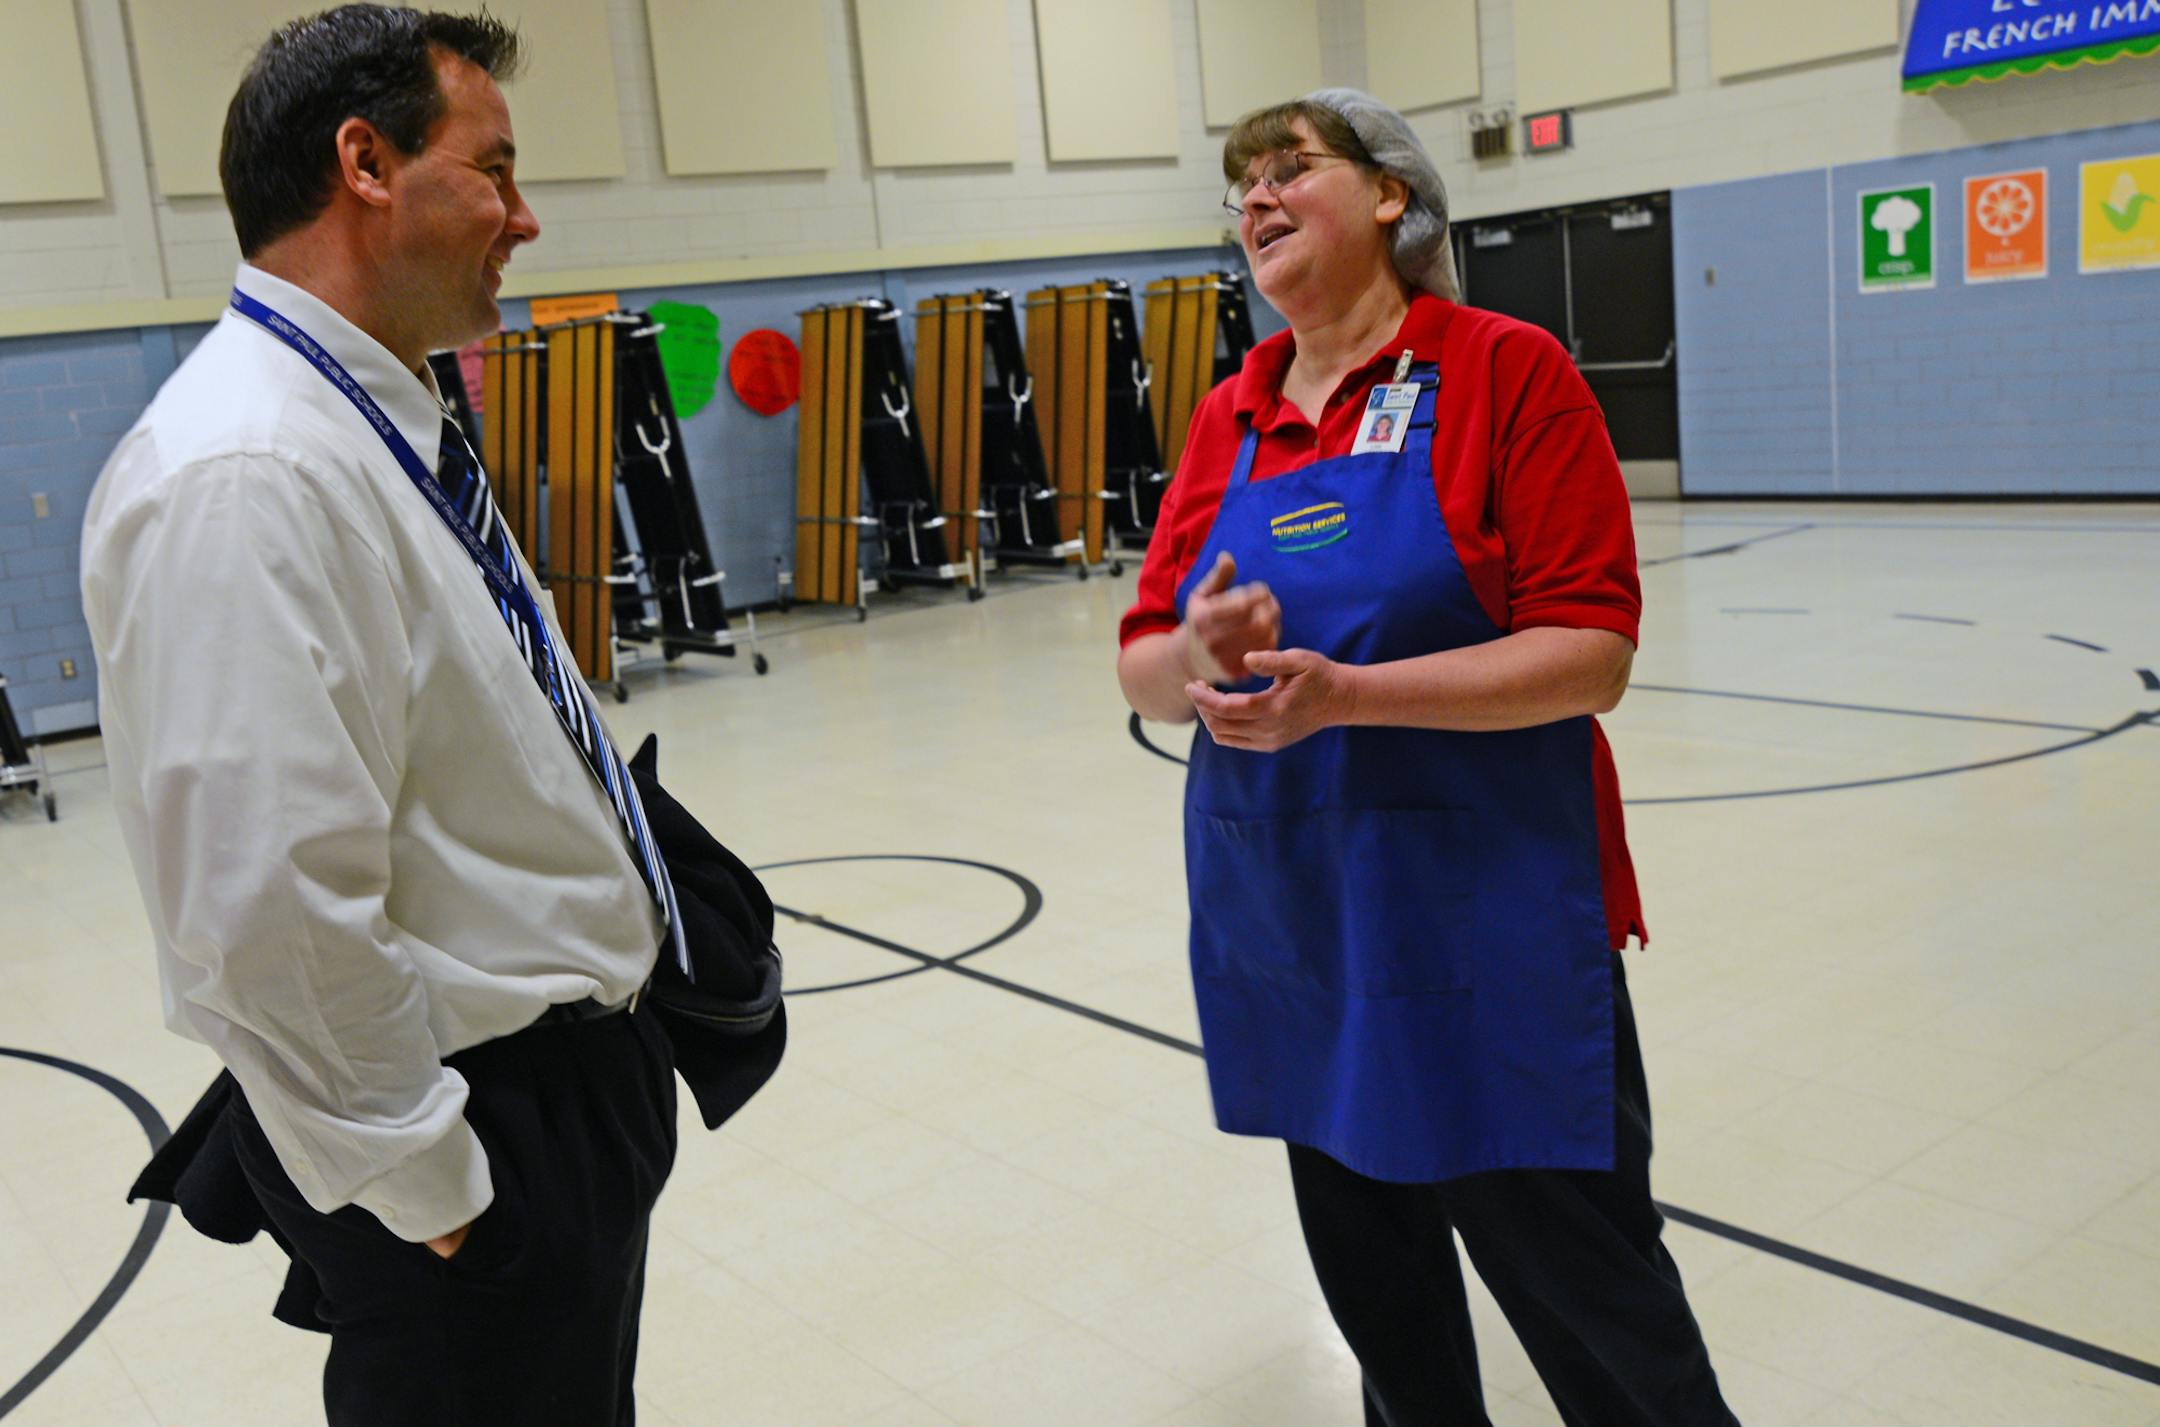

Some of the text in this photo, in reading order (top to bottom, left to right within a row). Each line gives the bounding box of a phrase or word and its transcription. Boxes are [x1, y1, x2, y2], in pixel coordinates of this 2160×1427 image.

[1943, 11, 2077, 58] FRENCH
[267, 314, 300, 341] SAINT
[318, 355, 354, 391] PUBLIC
[350, 388, 394, 437] SCHOOLS
[420, 476, 515, 594] SAINT PAUL PUBLIC SCHOOLS
[1272, 522, 1311, 536] NUTRITION
[1313, 511, 1345, 530] SERVICES
